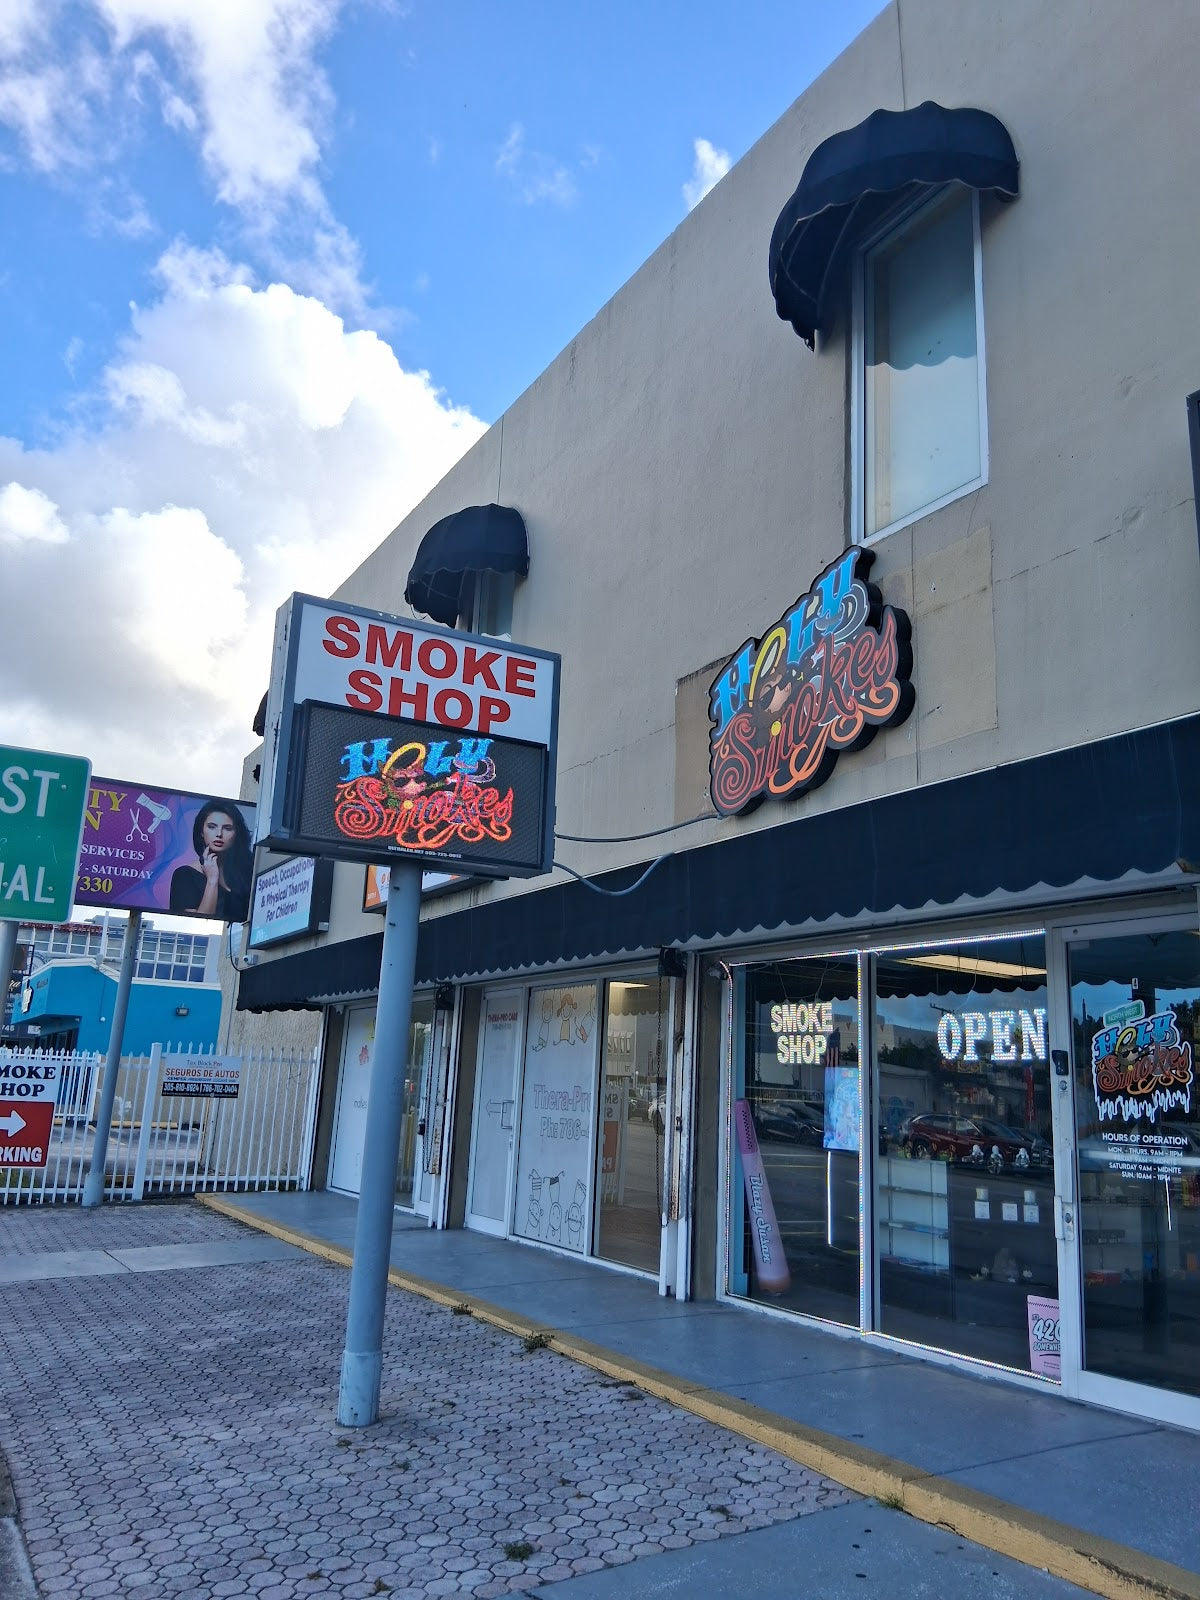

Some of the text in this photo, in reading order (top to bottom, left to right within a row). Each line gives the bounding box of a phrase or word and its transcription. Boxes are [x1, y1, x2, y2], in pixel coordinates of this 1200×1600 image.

[714, 551, 857, 735] HOLY
[322, 615, 537, 698] SMOKE
[345, 669, 511, 734] SHOP
[339, 737, 495, 781] HOLY
[0, 766, 60, 817] ST
[89, 788, 128, 812] TY
[84, 810, 103, 831] N
[81, 843, 145, 861] SERVICES
[91, 864, 153, 880] SATURDAY
[266, 886, 288, 906] Physical
[288, 878, 311, 896] Therapy
[266, 901, 298, 922] For Children
[770, 1002, 834, 1033] SMOKE
[937, 1008, 1047, 1061] OPEN
[776, 1034, 827, 1064] SHOP
[0, 1064, 56, 1080] MOKE
[165, 1068, 240, 1078] SEGUROS DE AUTOS
[0, 1082, 45, 1097] HOP
[1102, 1132, 1188, 1146] HOURS OF OPERATION
[1107, 1146, 1124, 1154] MON.
[1129, 1147, 1150, 1155] THURS.
[1150, 1149, 1164, 1157] 9AM
[1169, 1150, 1183, 1158] 11PM
[1108, 1162, 1137, 1171] SATURDAY
[1138, 1164, 1152, 1172] 9AM
[1157, 1166, 1182, 1174] MIDNITE
[1136, 1172, 1152, 1180] 10AM
[1157, 1173, 1171, 1182] 11PM
[749, 1173, 772, 1264] Blazy Susan
